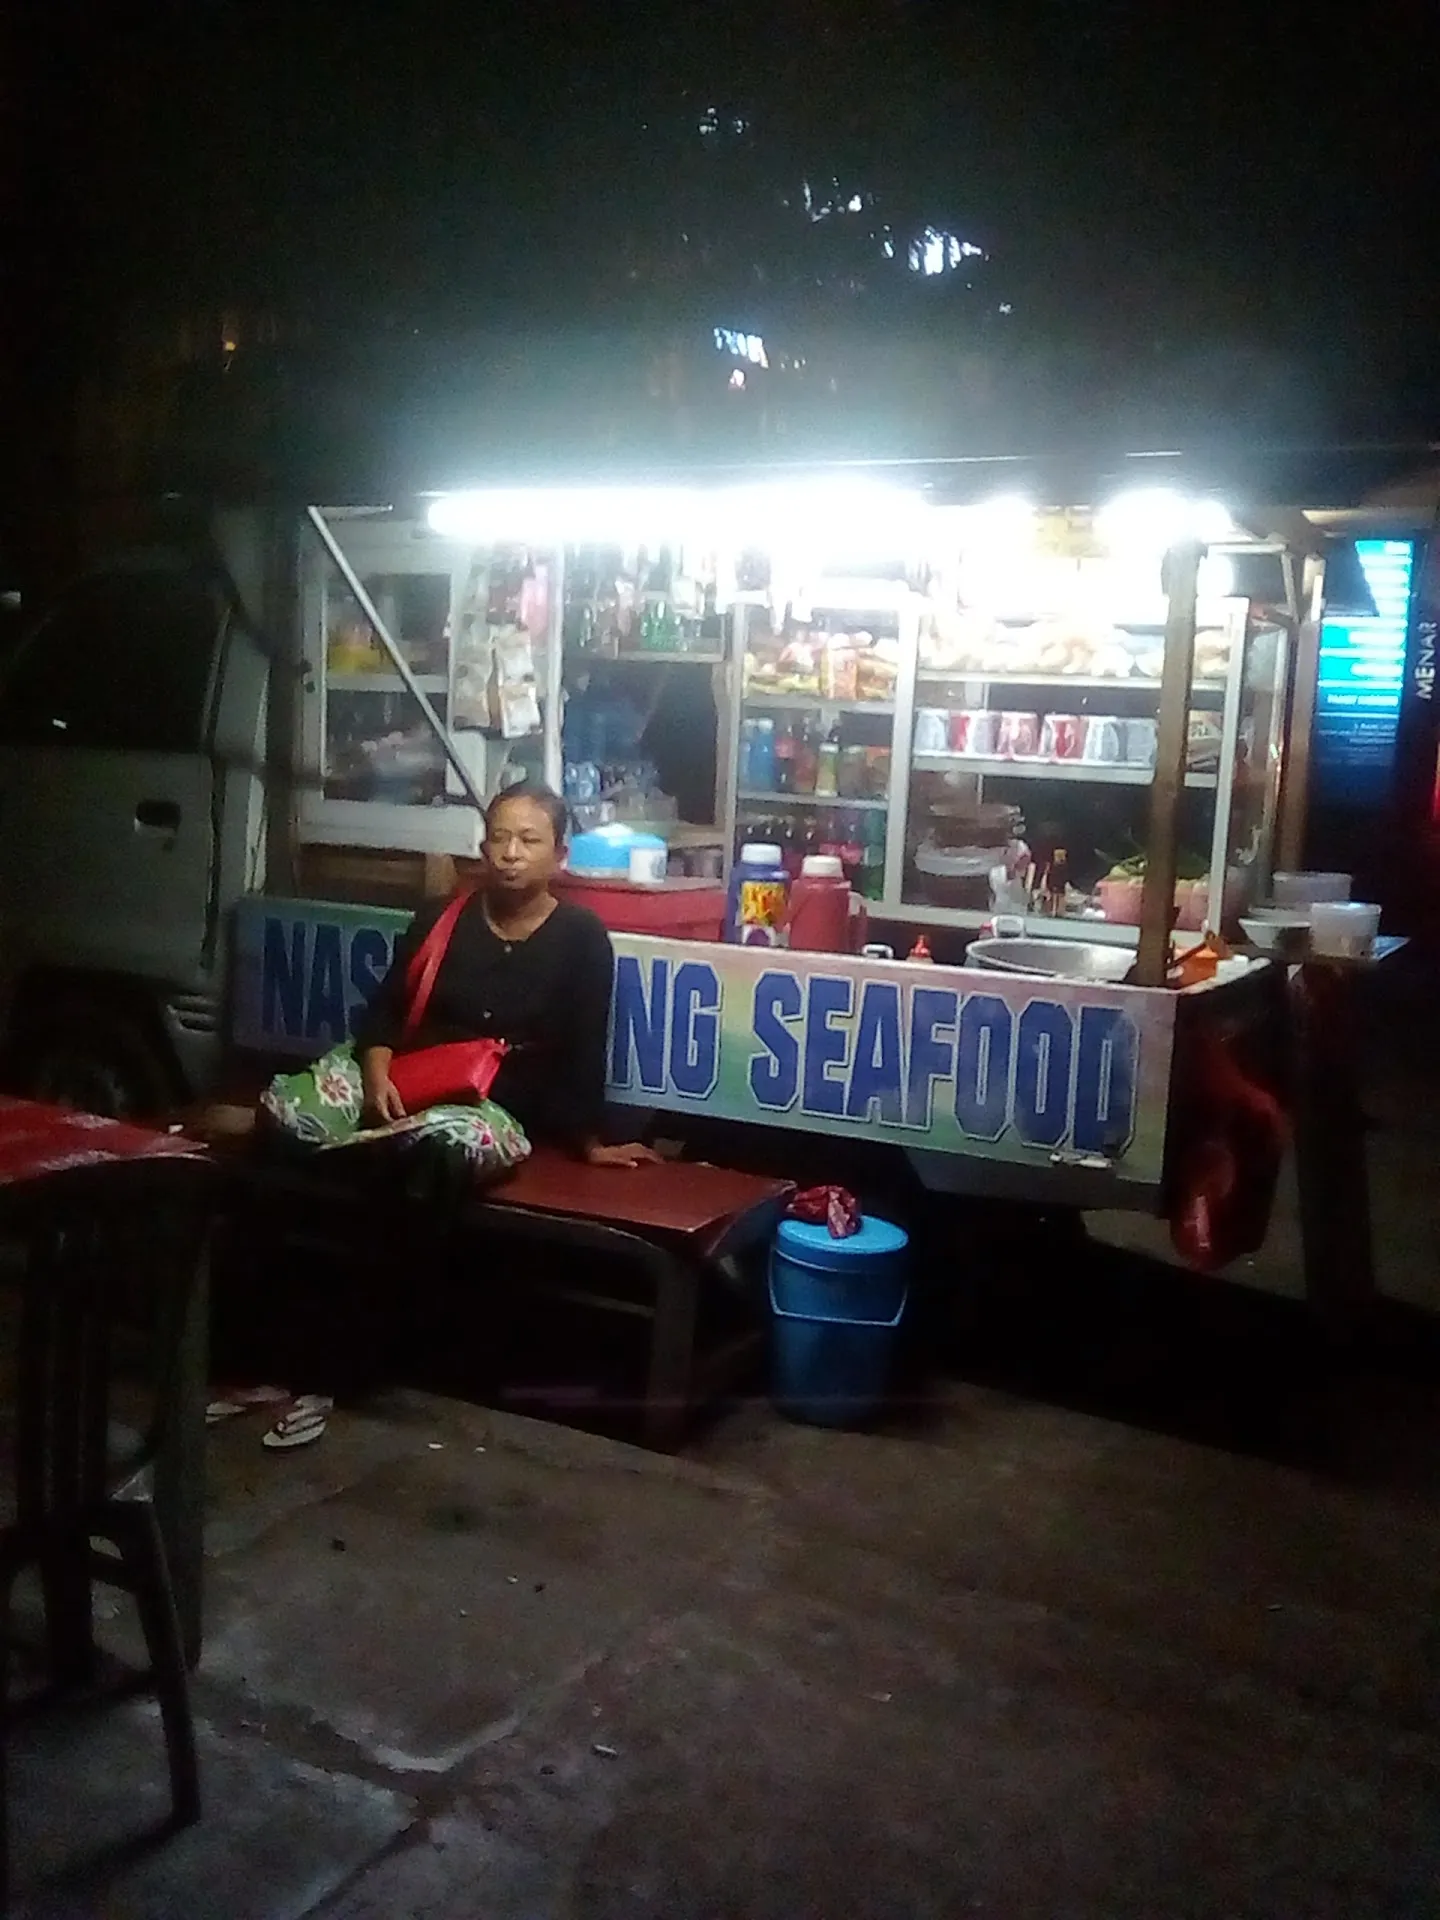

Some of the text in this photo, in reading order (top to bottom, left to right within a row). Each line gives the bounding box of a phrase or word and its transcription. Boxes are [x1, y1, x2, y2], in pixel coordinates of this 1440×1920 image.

[261, 914, 1141, 1158] NAS NG SEAFOOD
